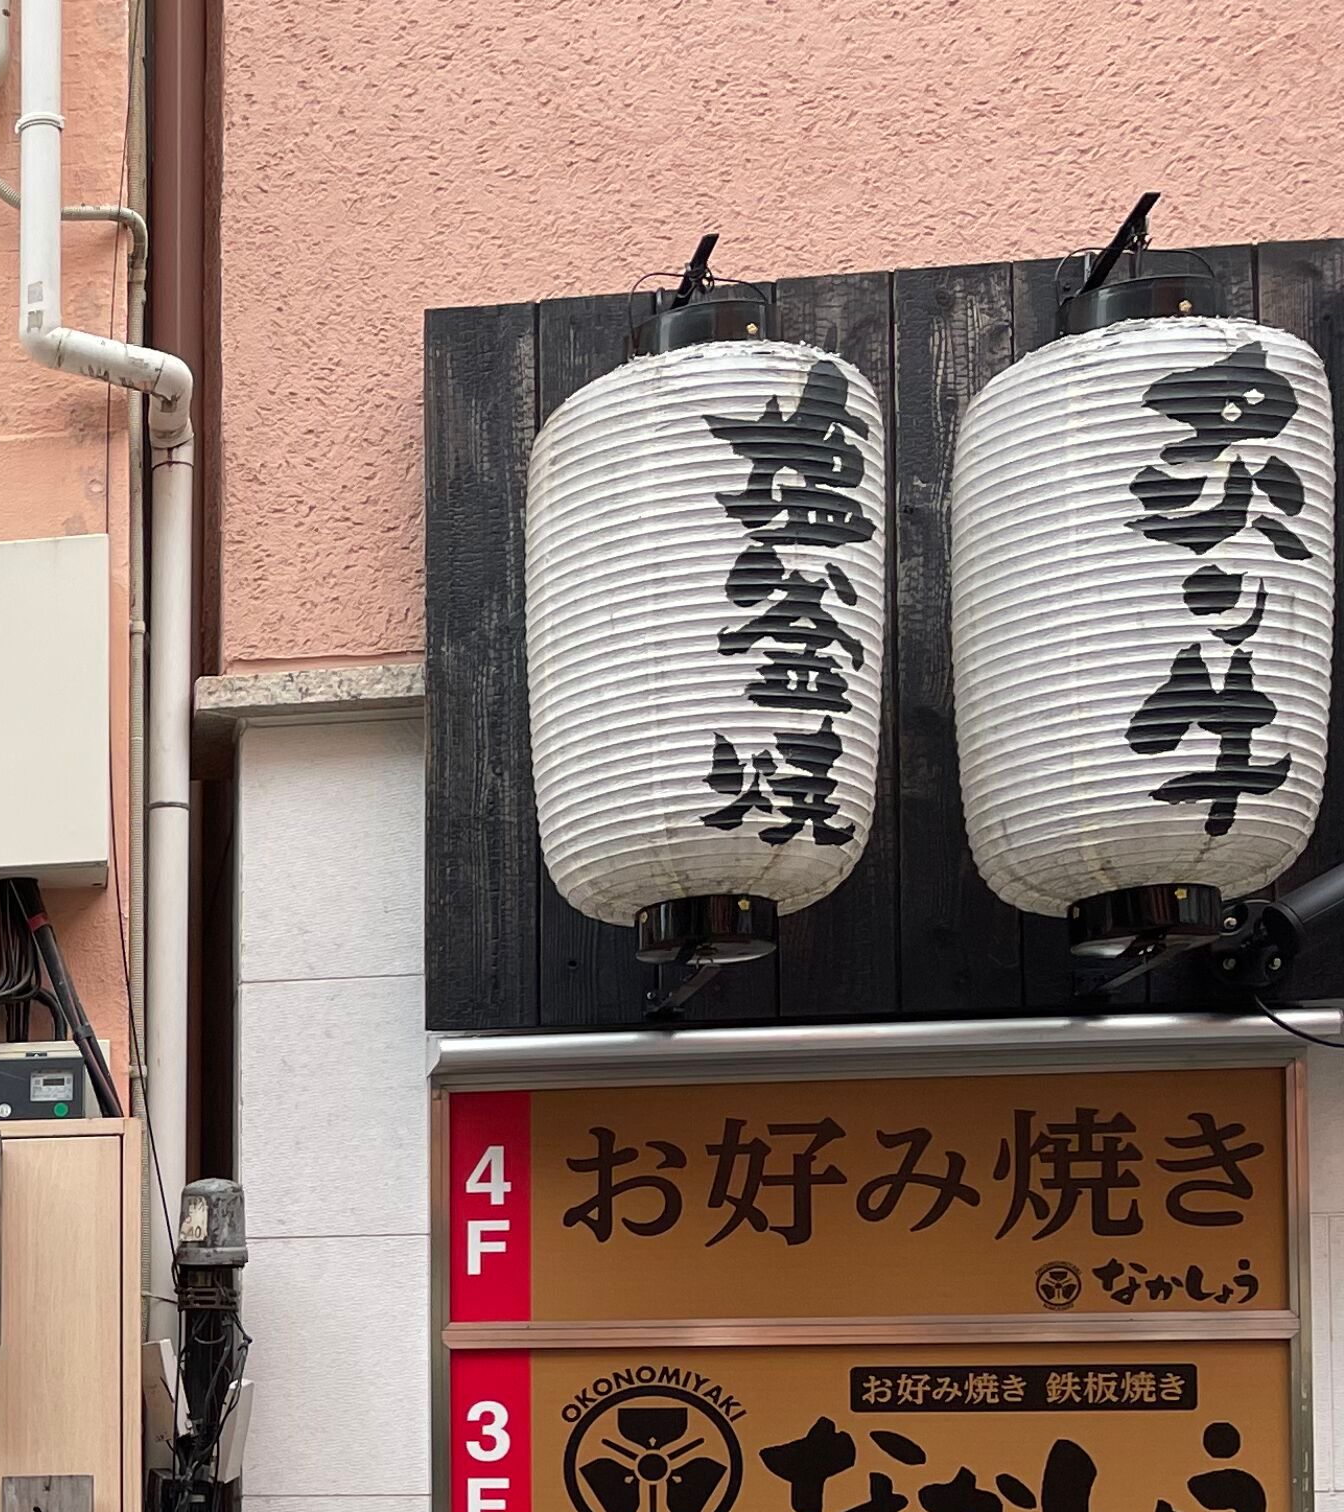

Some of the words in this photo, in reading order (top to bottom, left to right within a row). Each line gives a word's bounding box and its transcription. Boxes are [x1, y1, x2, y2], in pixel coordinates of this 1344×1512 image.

[562, 1106, 1267, 1249] お好み焼き
[1091, 1257, 1259, 1306] なかしょう
[559, 1364, 748, 1427] OKONOMIYAKI
[860, 1372, 1028, 1406] お好み焼き
[1045, 1370, 1186, 1405] 鉄板焼き
